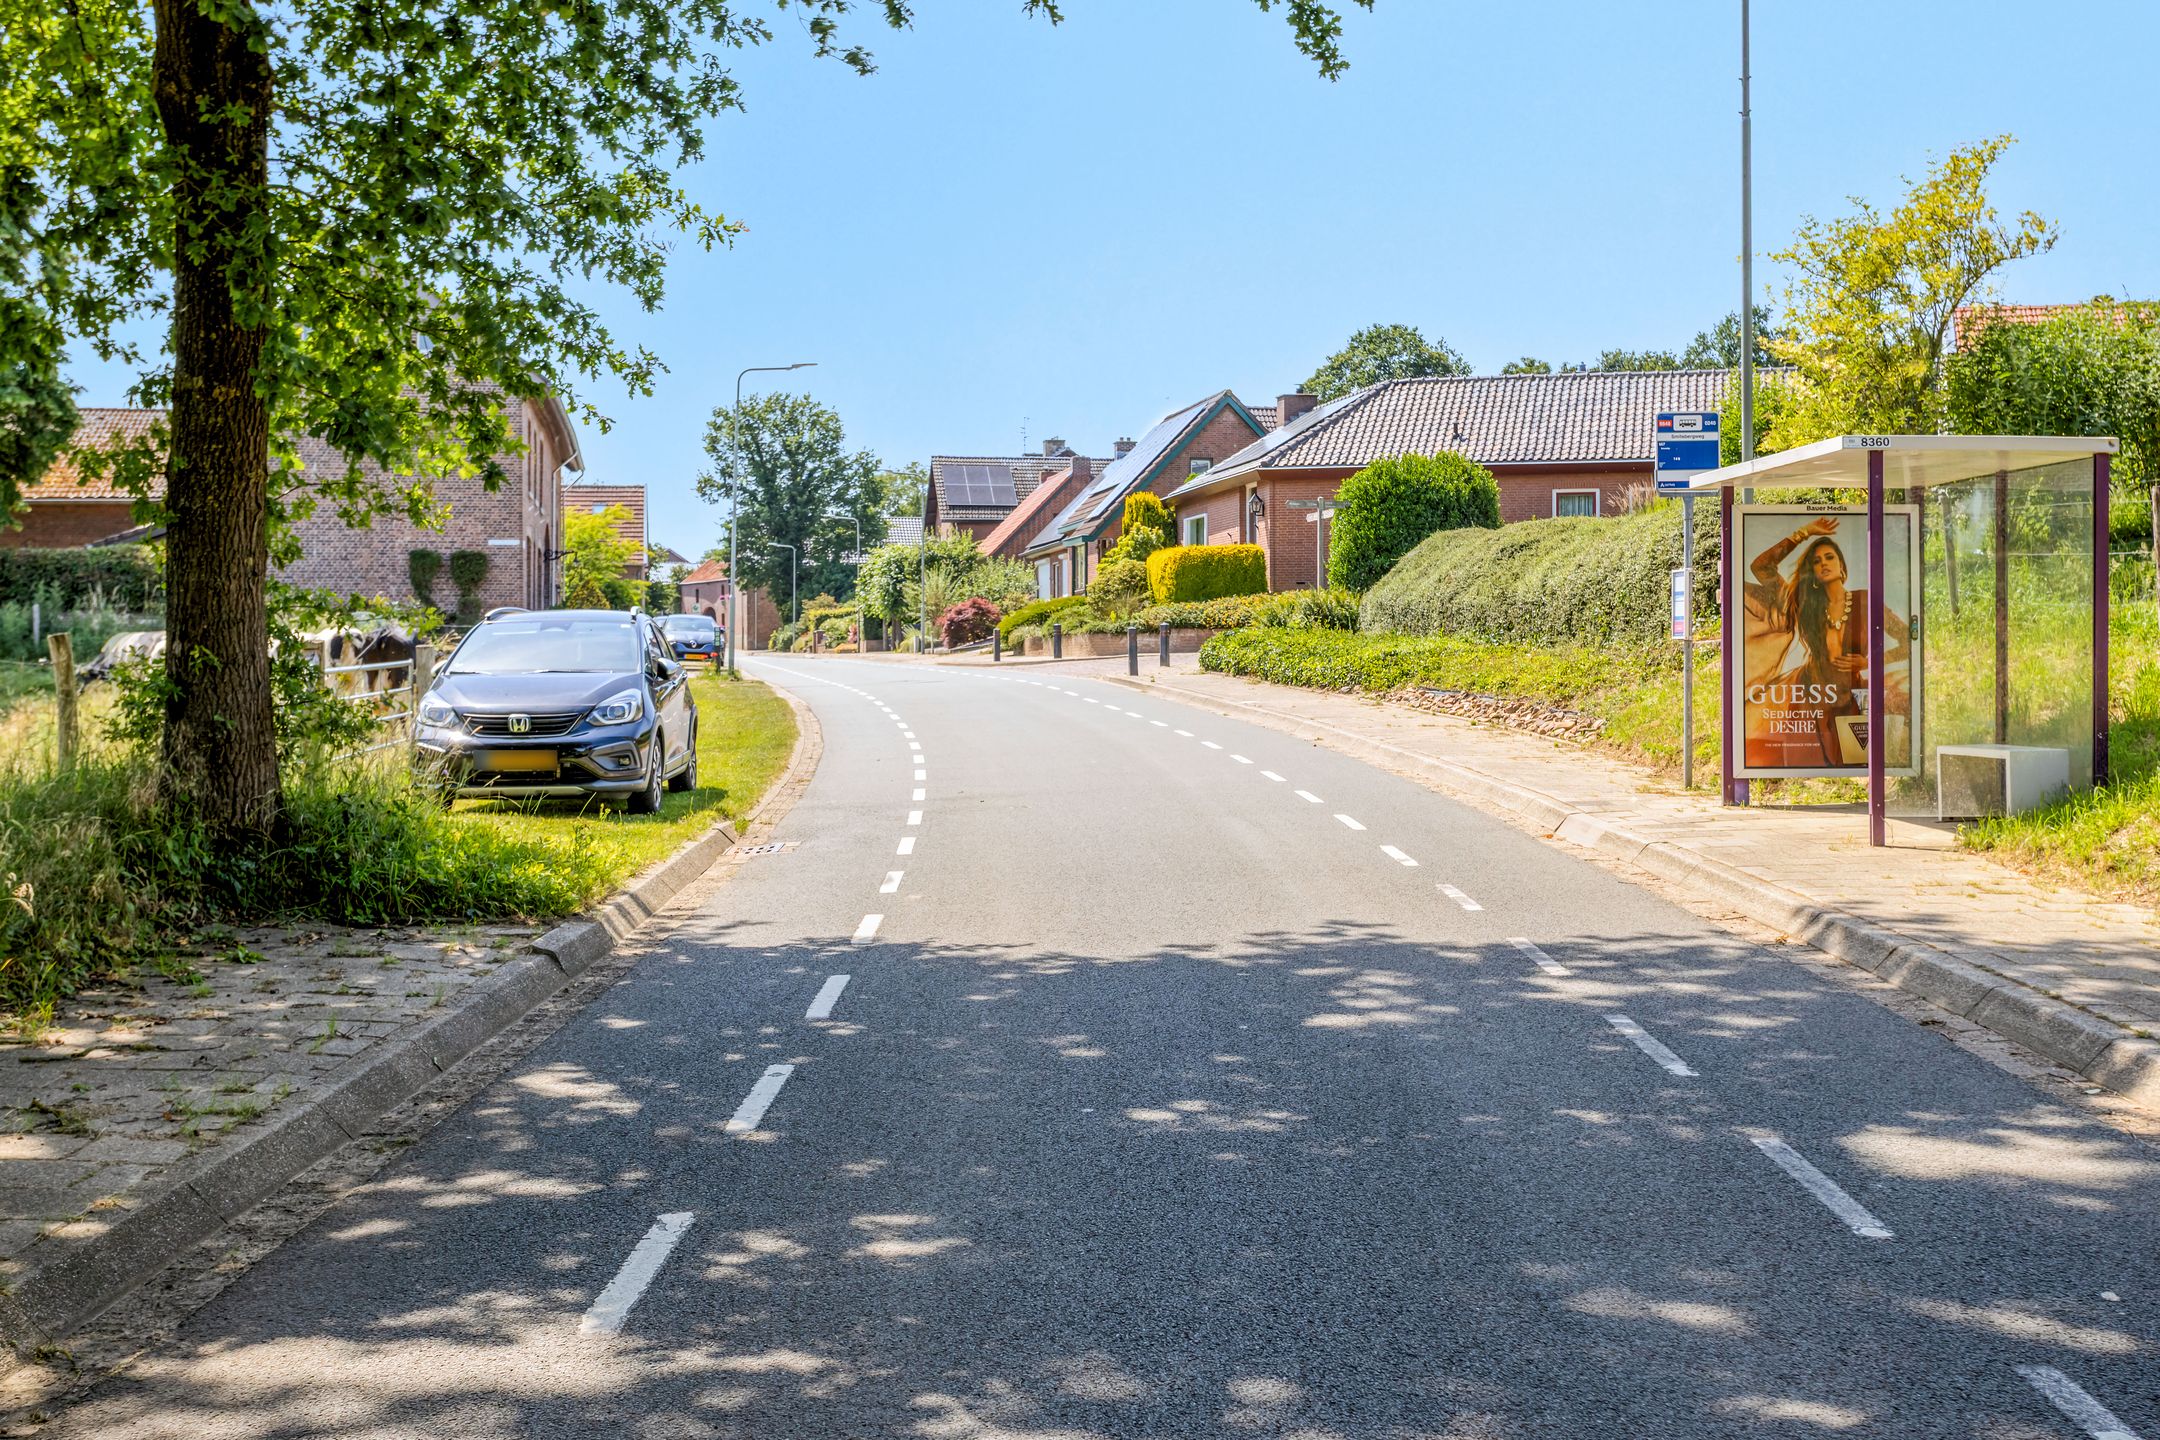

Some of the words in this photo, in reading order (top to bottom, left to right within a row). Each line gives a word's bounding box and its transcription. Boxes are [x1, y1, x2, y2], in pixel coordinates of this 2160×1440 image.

[1861, 437, 1890, 447] 8360
[1748, 684, 1838, 704] GUESS
[1762, 708, 1824, 719] SEDUCTIVE
[1769, 720, 1817, 734] DESIRE
